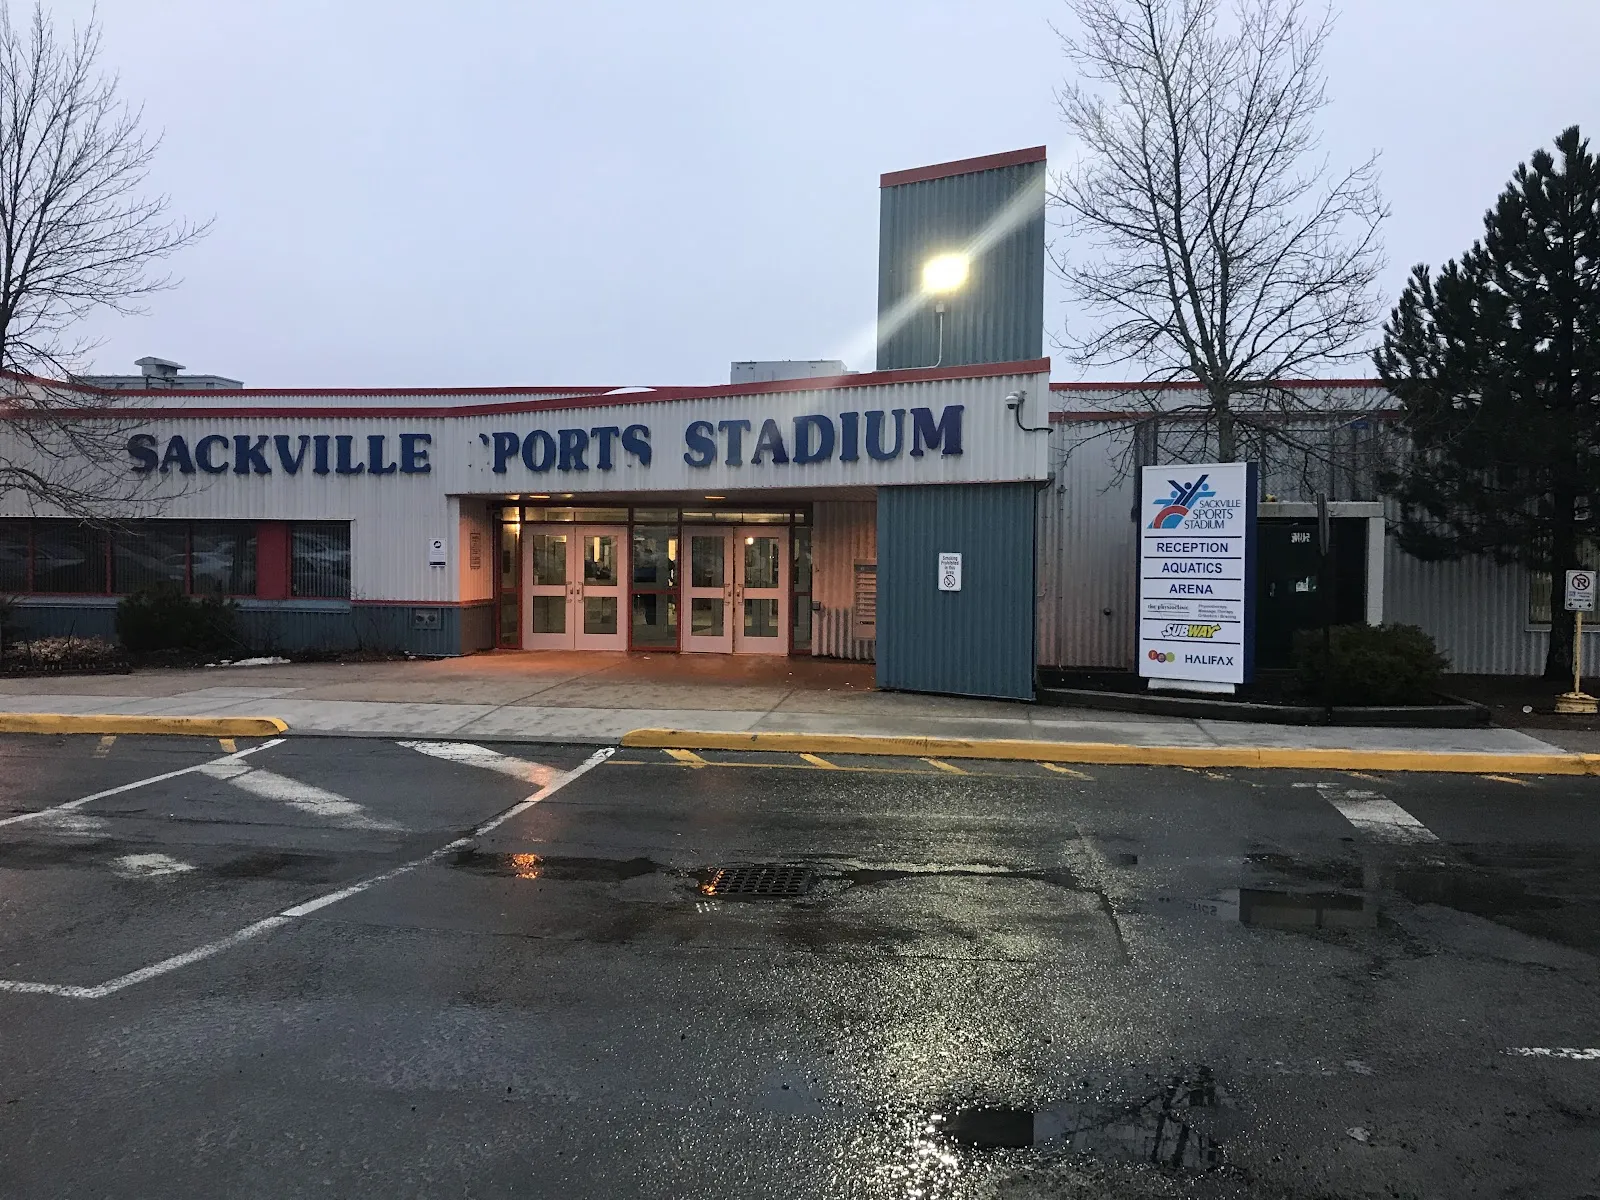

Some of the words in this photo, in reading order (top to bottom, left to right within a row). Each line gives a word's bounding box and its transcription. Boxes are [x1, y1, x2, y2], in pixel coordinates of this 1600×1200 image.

[127, 433, 432, 475] SACKVILLE
[479, 424, 652, 474] PORTS
[684, 405, 965, 468] STADIUM
[1199, 499, 1241, 508] SACKVILLE
[1192, 509, 1234, 520] SPORTS
[1184, 520, 1225, 530] STADIUM
[1156, 542, 1229, 553] RECEPTION
[1161, 562, 1223, 574] AQUATICS
[1169, 584, 1214, 594] ARENA
[1161, 623, 1221, 638] SUBWAY
[1184, 654, 1234, 666] HALIFAX
